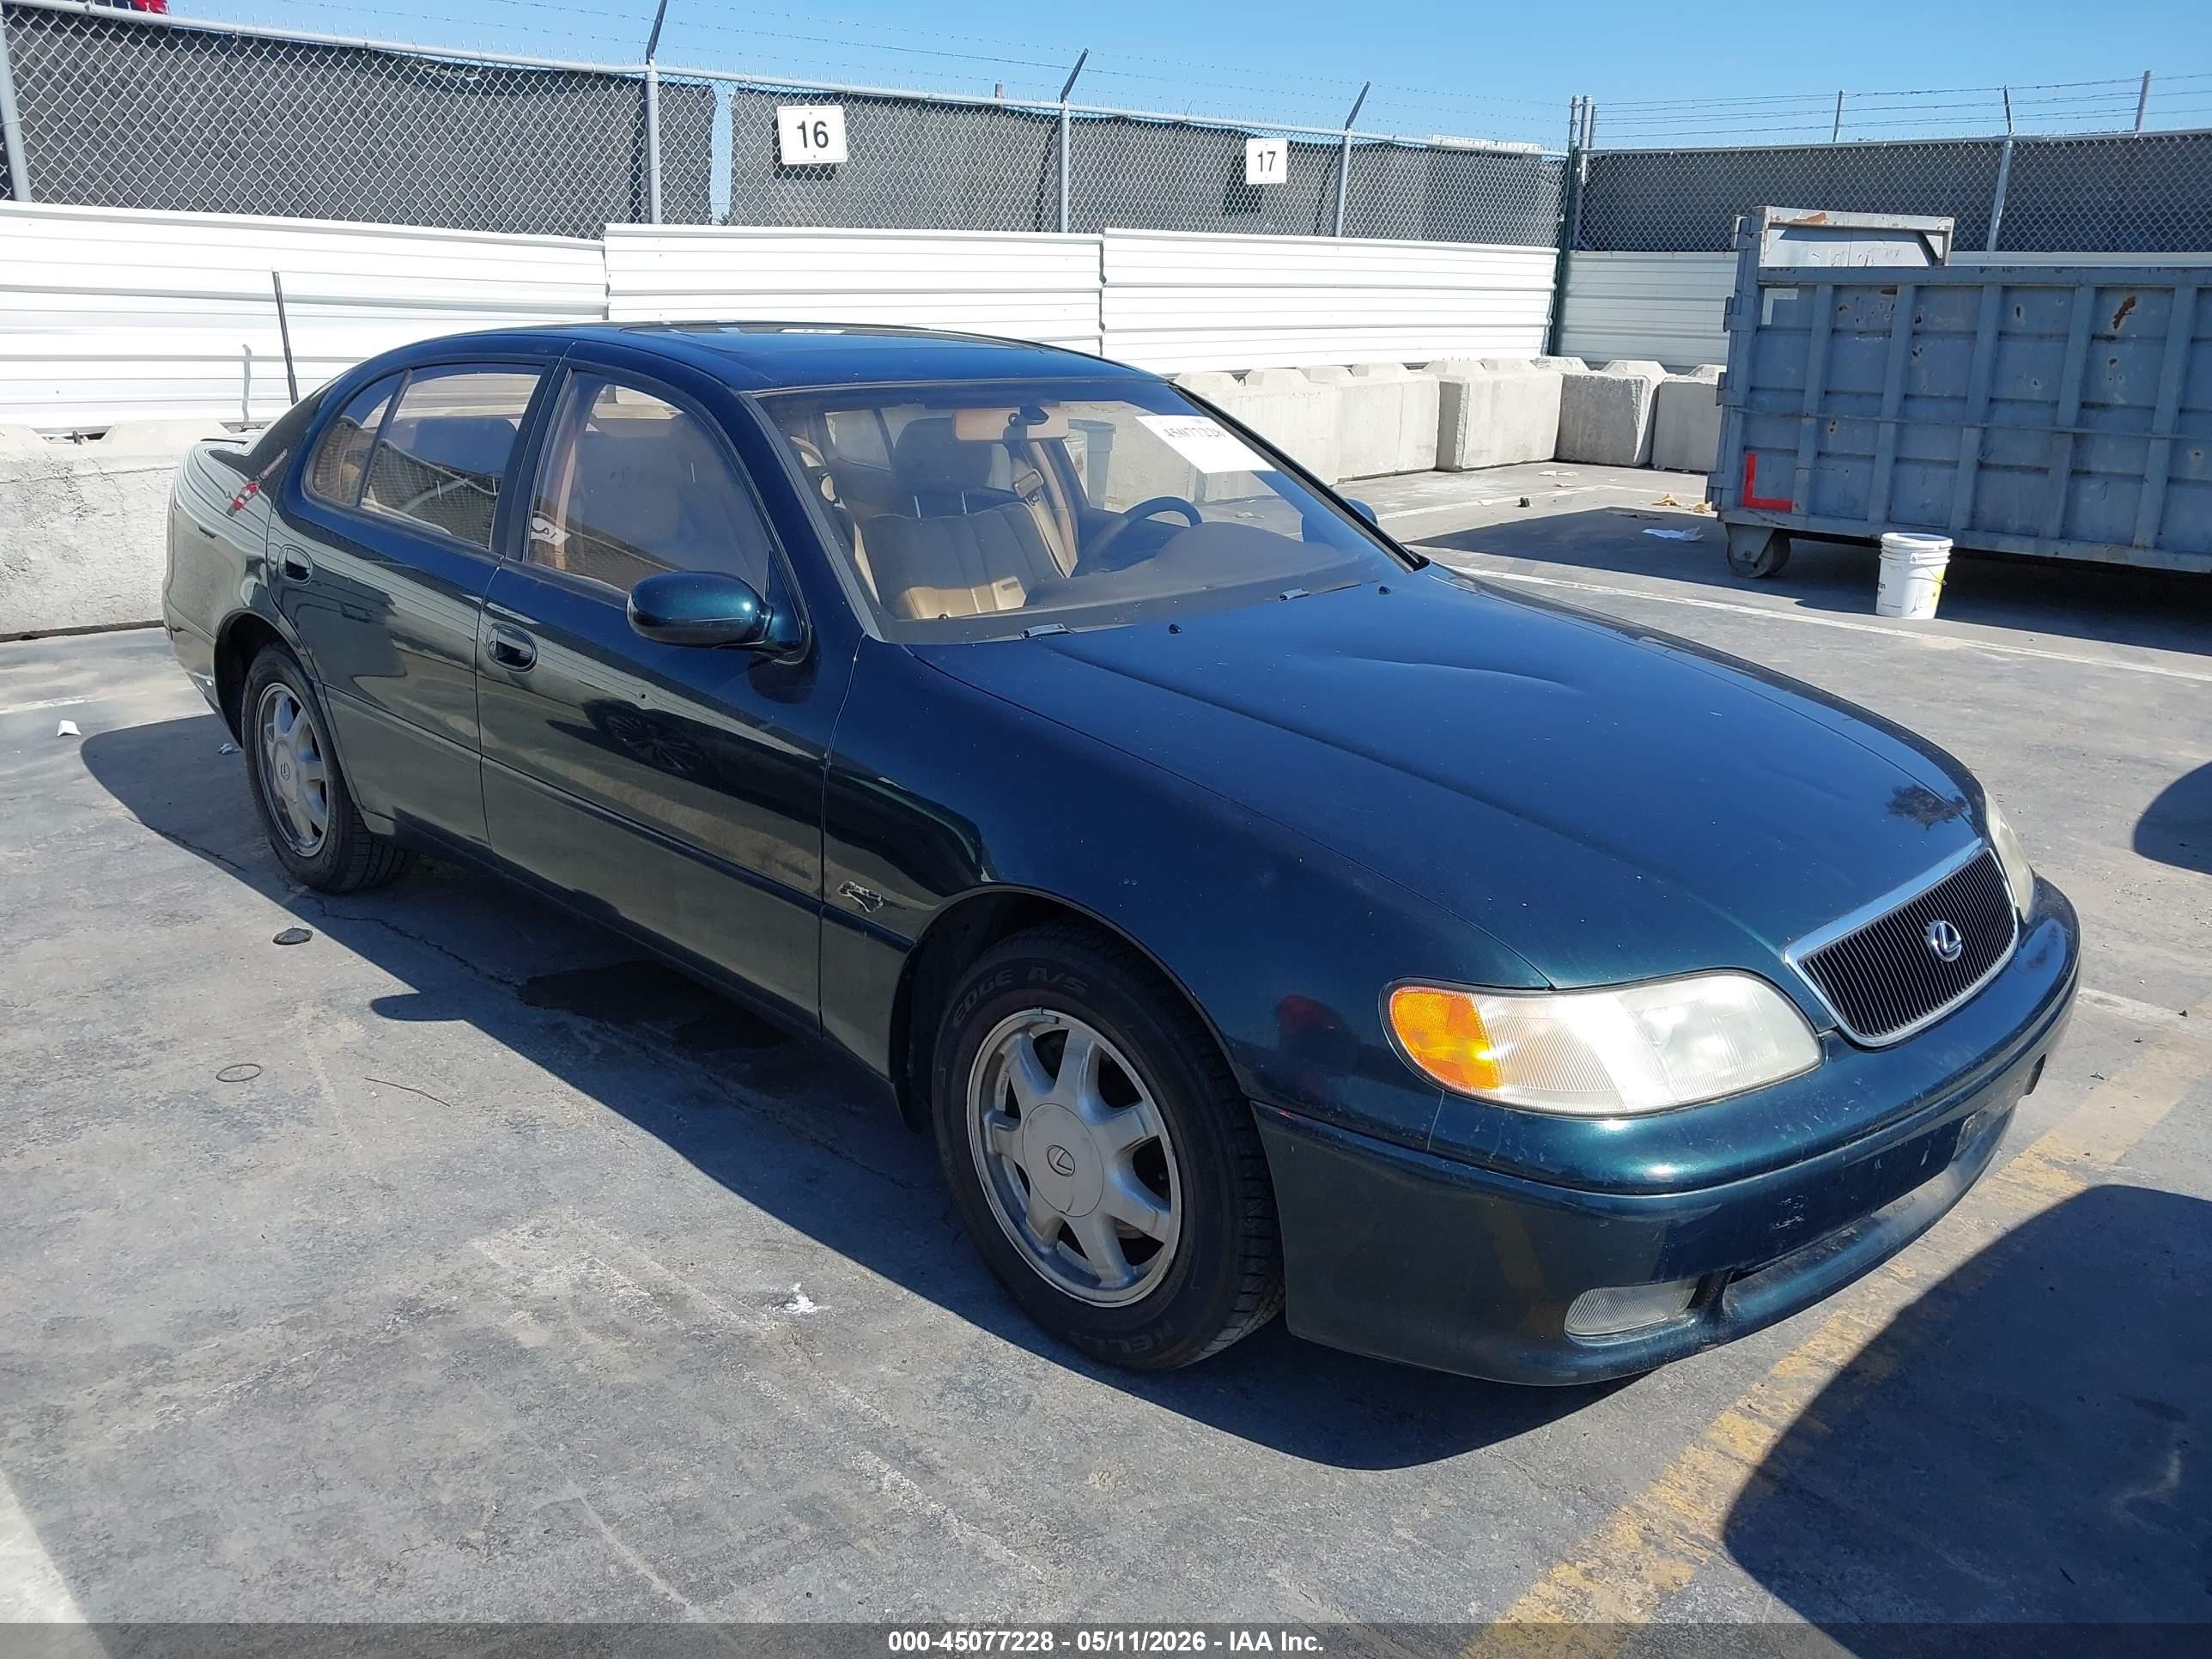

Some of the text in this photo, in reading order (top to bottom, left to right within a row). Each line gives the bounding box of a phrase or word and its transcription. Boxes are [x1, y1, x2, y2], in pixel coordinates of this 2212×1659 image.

[796, 120, 830, 149] 16
[1257, 150, 1277, 173] 17
[952, 966, 1091, 1029] EDGE A/S
